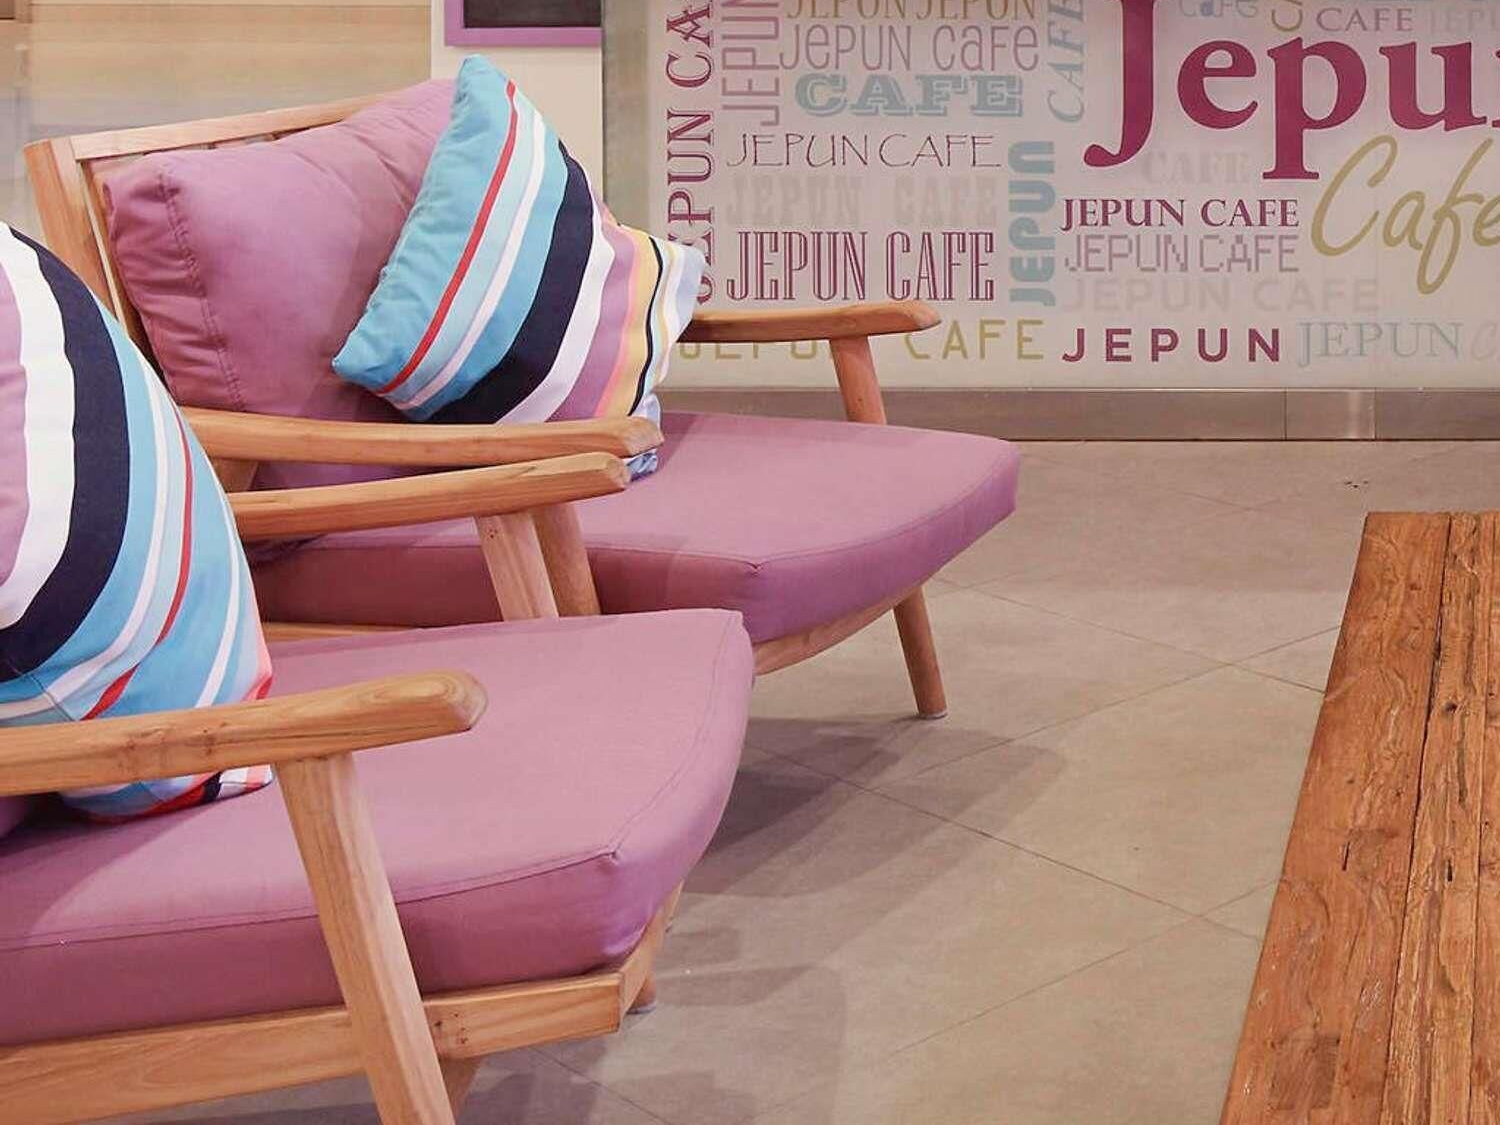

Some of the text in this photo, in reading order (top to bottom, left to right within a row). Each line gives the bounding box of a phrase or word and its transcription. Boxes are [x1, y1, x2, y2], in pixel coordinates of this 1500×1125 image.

[1316, 7, 1414, 33] CAFE
[794, 74, 1024, 118] CAFE
[727, 133, 1001, 168] JEPUN CAFE
[1061, 198, 1300, 231] JEPUN CAFE
[727, 231, 995, 302] JEPUN CAFE
[1064, 234, 1299, 273] JEPUN CAFE
[904, 319, 1046, 361] CAFE
[1061, 328, 1281, 363] JEPUN
[1296, 321, 1464, 369] JEPUN
